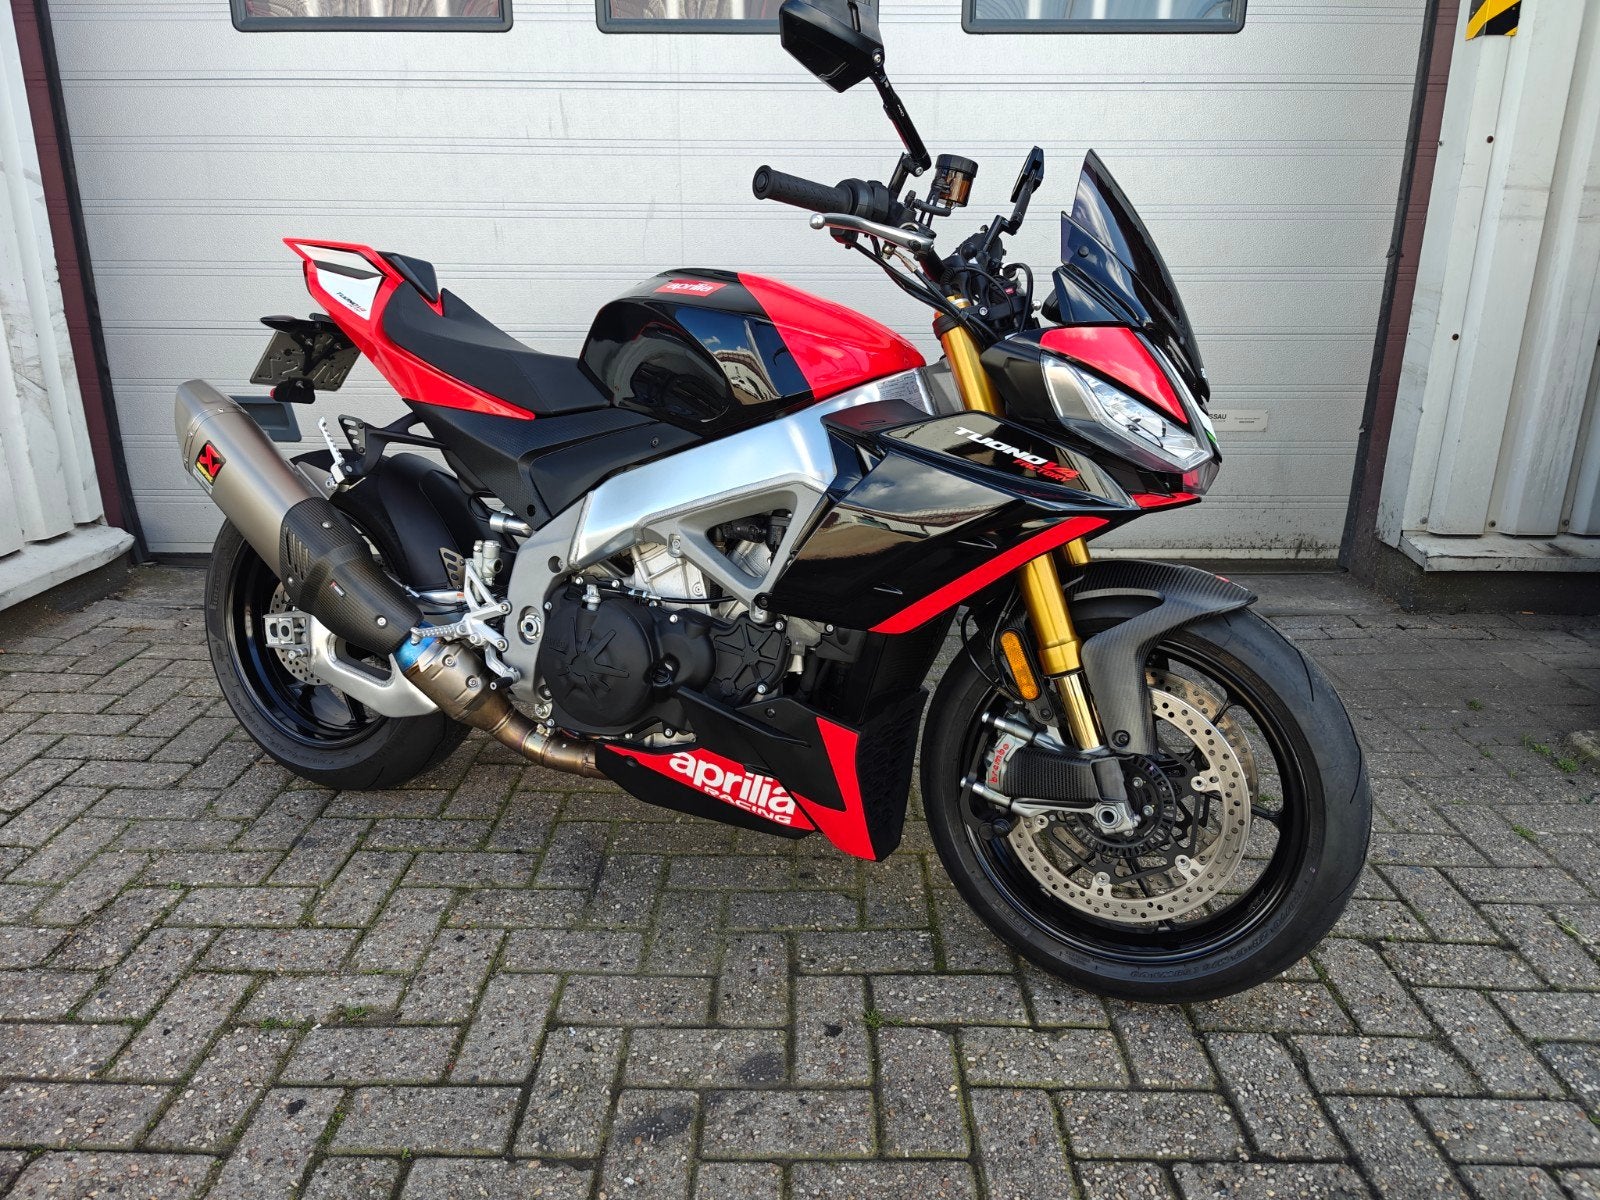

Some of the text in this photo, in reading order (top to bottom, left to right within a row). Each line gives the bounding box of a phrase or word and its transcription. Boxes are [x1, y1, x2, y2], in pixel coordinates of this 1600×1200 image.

[666, 282, 714, 292] aprilia
[954, 426, 1080, 479] TUONO V4
[1013, 459, 1072, 482] FACTORY
[668, 751, 797, 816] aprilia
[988, 743, 1010, 784] brembo
[703, 786, 793, 825] RACING
